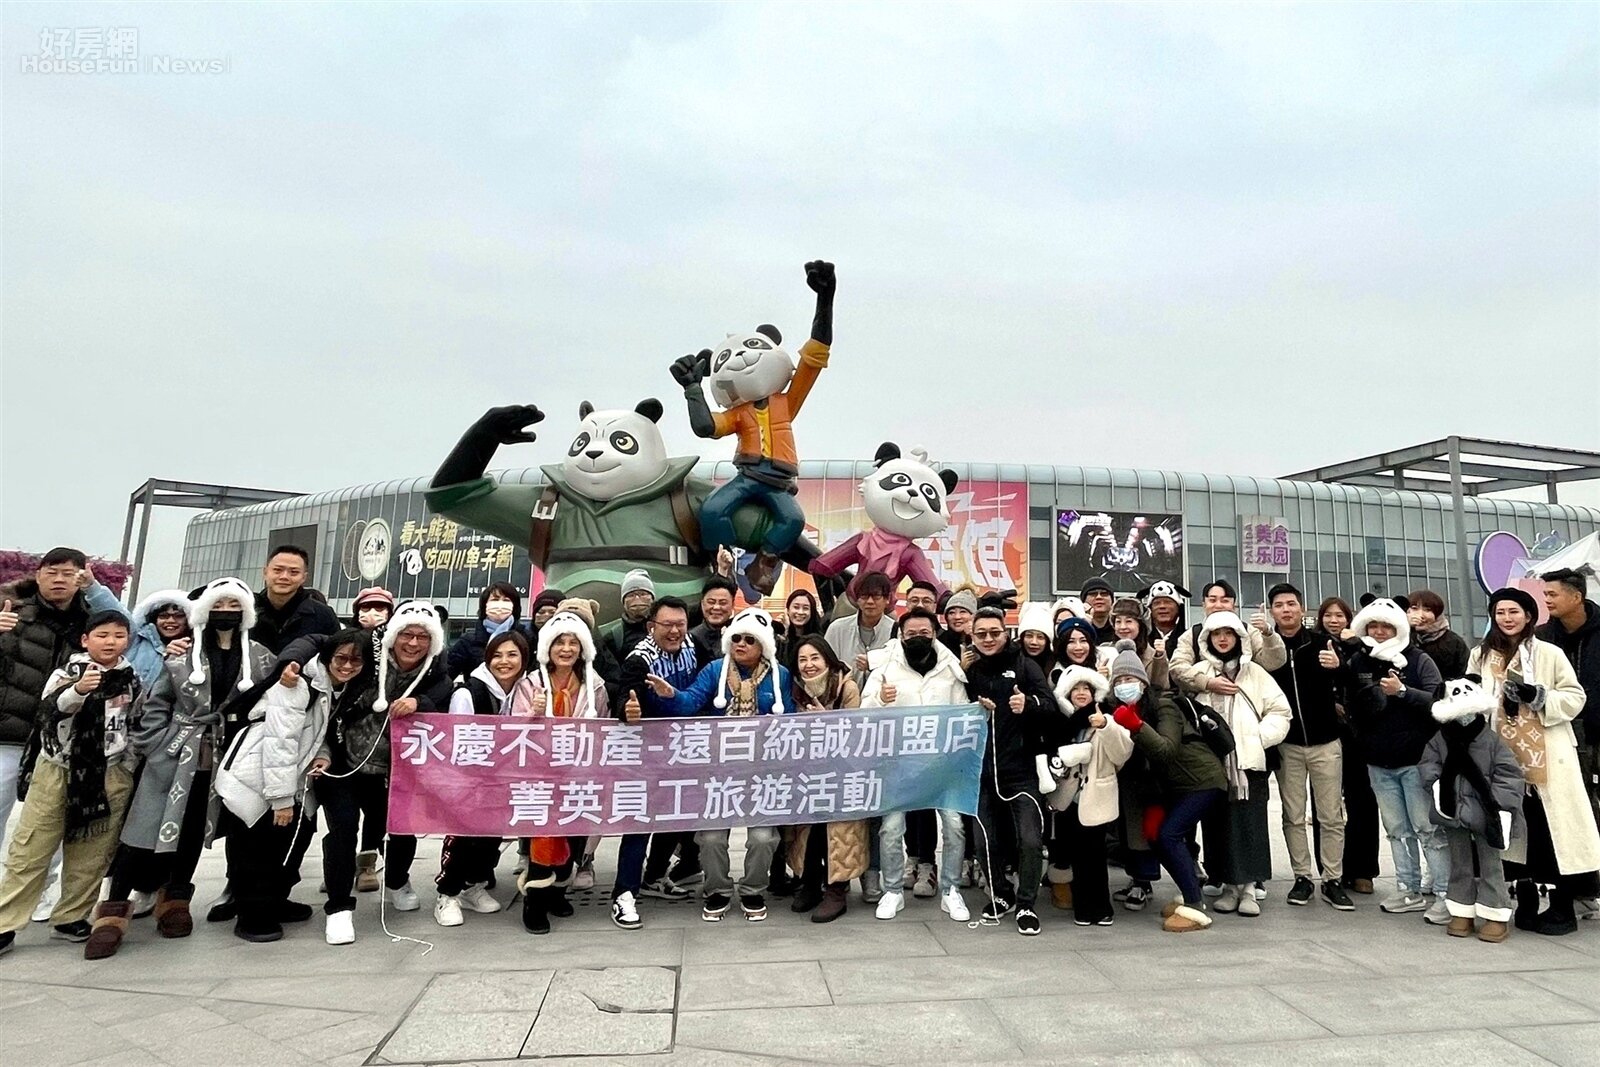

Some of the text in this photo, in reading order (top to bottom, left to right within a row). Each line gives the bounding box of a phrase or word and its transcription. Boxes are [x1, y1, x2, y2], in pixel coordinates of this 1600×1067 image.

[400, 715, 981, 768] 永慶不動產-遠百統誠加盟店
[508, 770, 882, 828] 菁英員工旅遊活動
